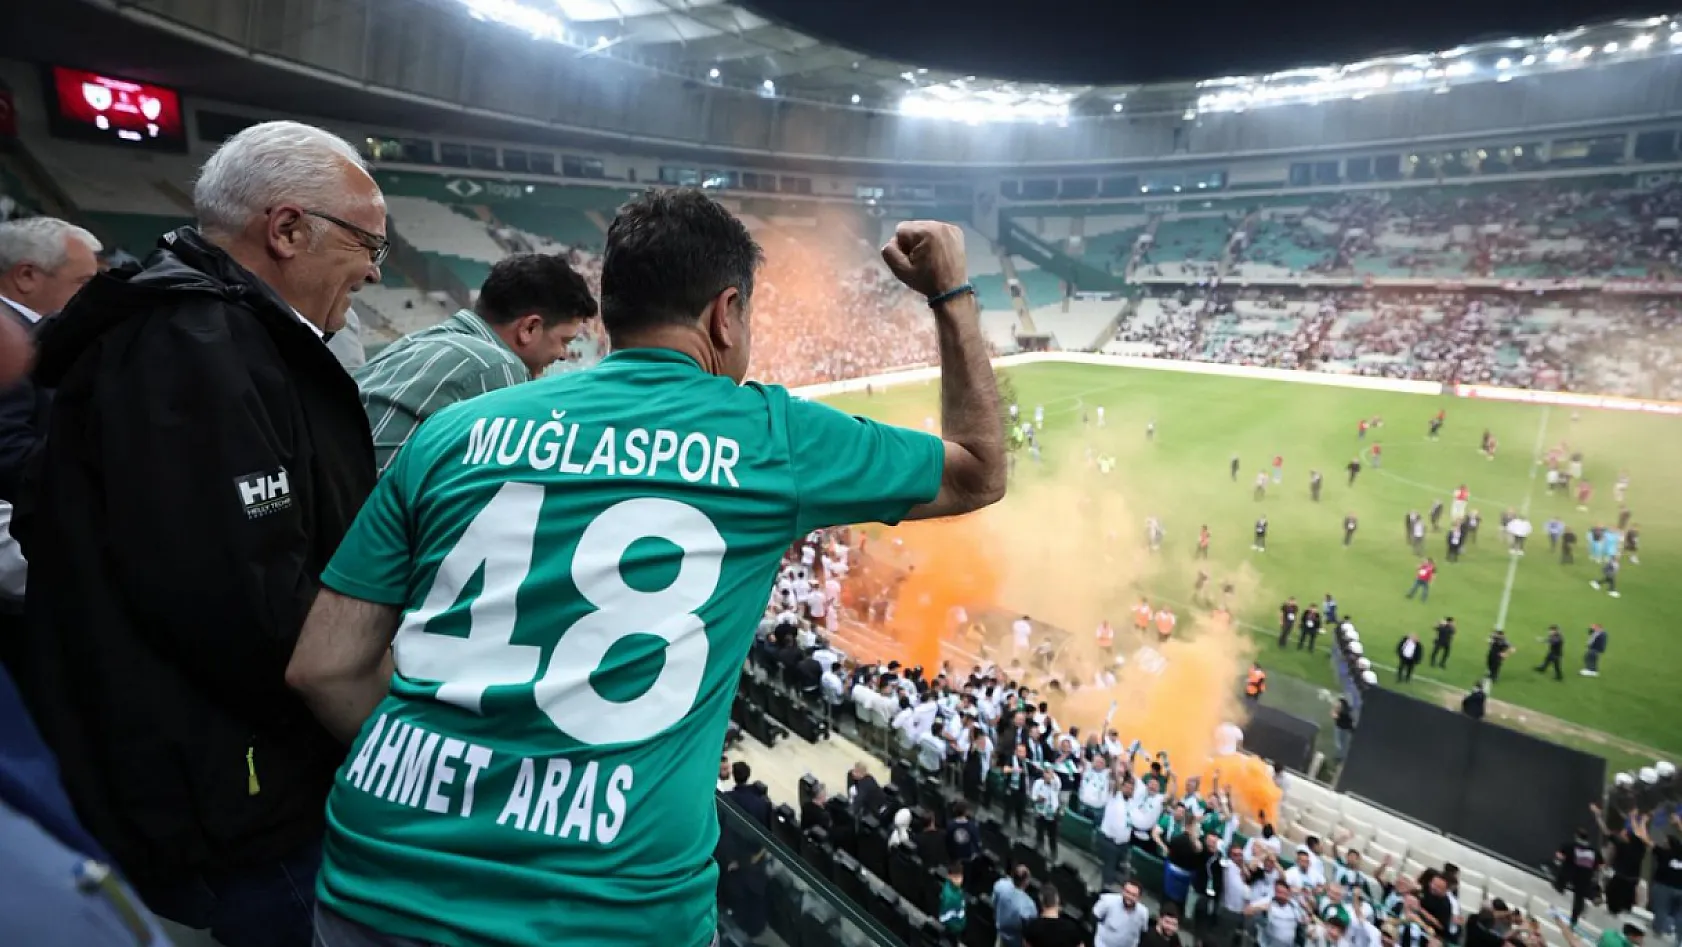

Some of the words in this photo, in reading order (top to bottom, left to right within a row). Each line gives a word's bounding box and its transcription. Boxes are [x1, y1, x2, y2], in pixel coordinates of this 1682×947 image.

[238, 472, 290, 505] HH
[462, 410, 740, 487] MUĞLASPOR
[392, 482, 726, 745] 48
[346, 713, 494, 818] AHMET
[496, 757, 634, 844] ARAS
